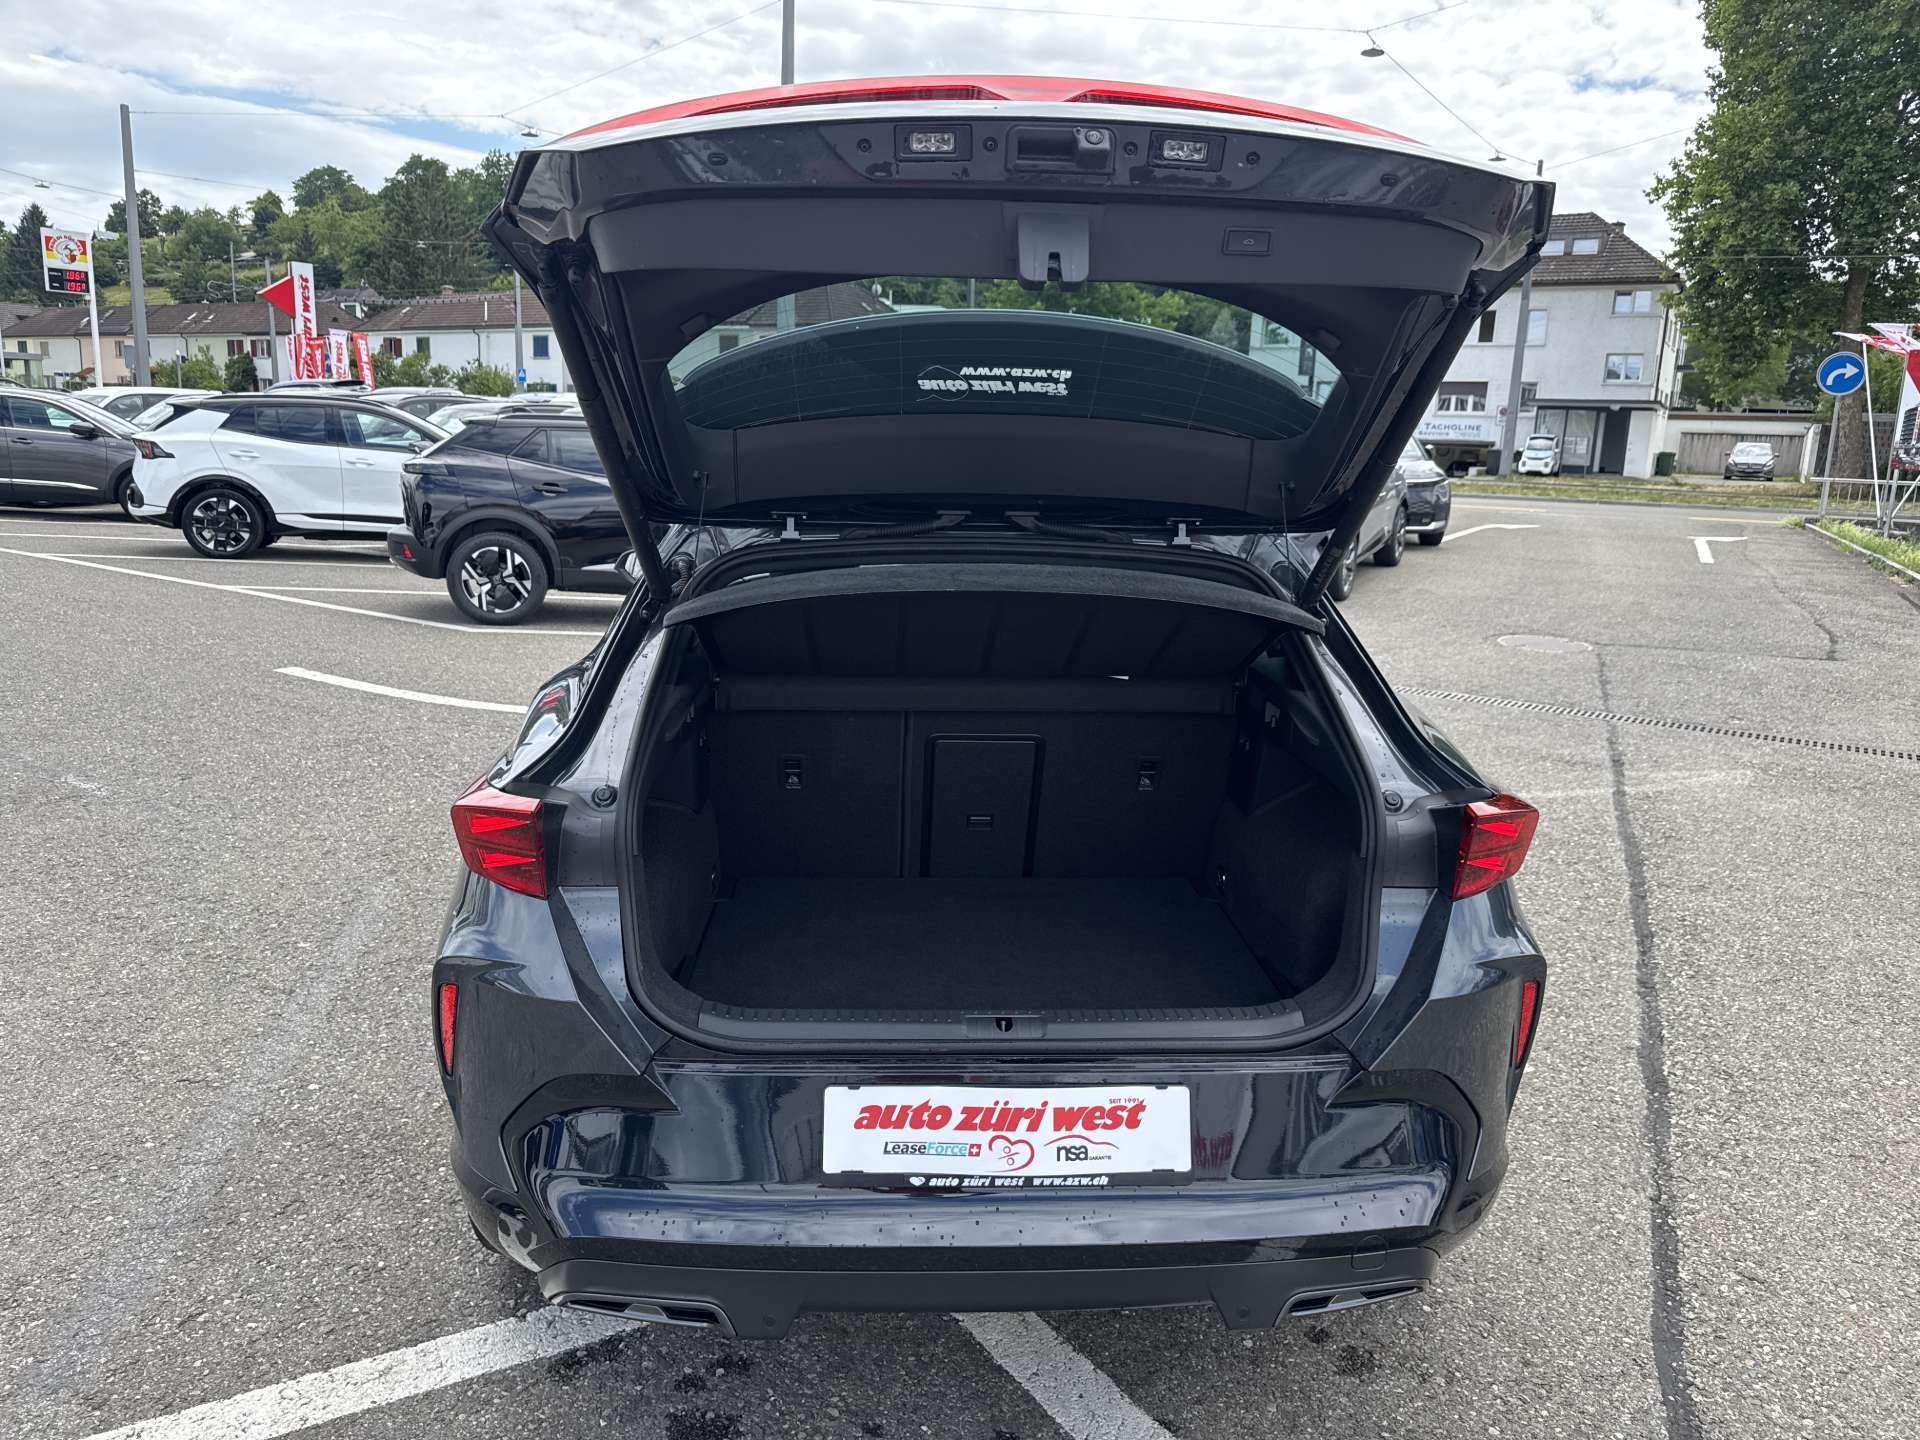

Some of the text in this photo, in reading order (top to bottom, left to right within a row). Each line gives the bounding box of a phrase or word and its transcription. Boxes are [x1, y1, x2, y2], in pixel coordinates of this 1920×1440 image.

[299, 274, 311, 313] west
[854, 1098, 1147, 1132] auto züri west
[883, 1142, 968, 1156] LeaseForce
[1056, 1145, 1088, 1162] nsa
[928, 1175, 1109, 1187] auto züri west www.azw.ch
